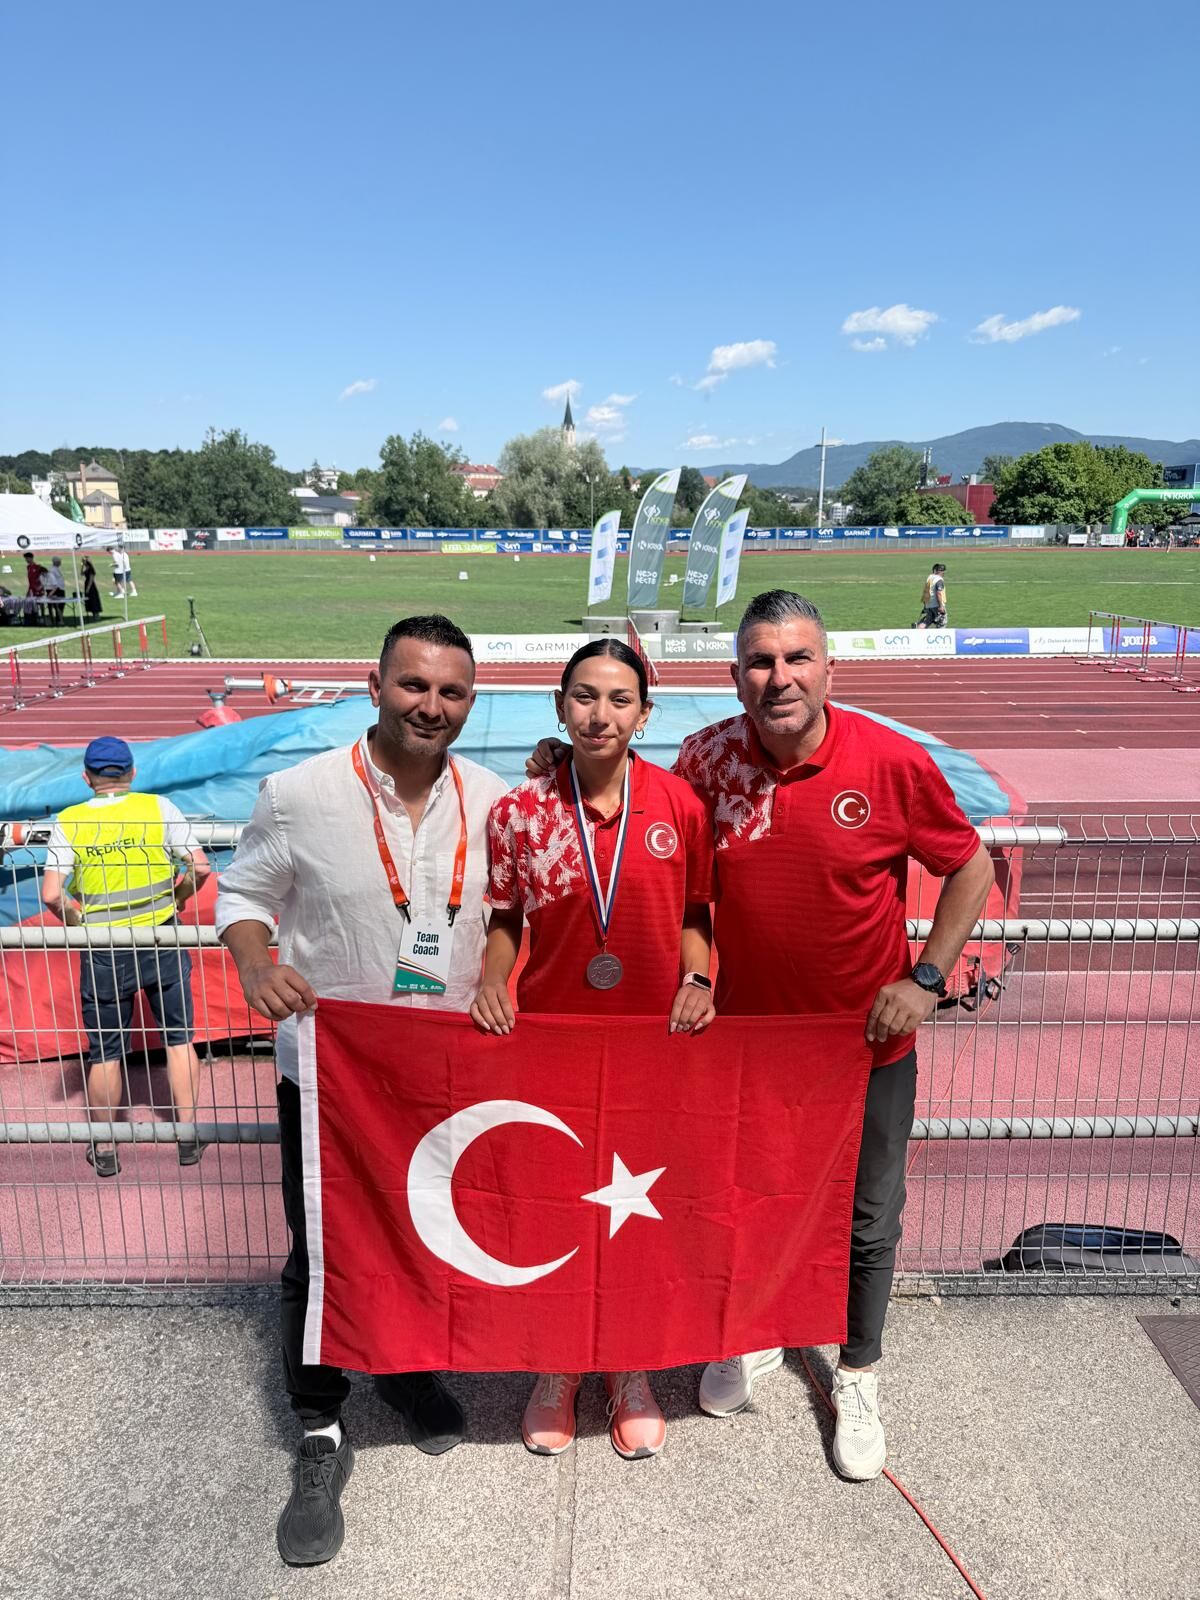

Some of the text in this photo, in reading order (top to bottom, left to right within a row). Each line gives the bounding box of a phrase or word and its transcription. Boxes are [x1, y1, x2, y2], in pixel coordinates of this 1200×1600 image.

[525, 642, 579, 652] GARMIN
[706, 641, 729, 650] KRKA
[416, 931, 439, 943] Team
[412, 944, 439, 956] Coach
